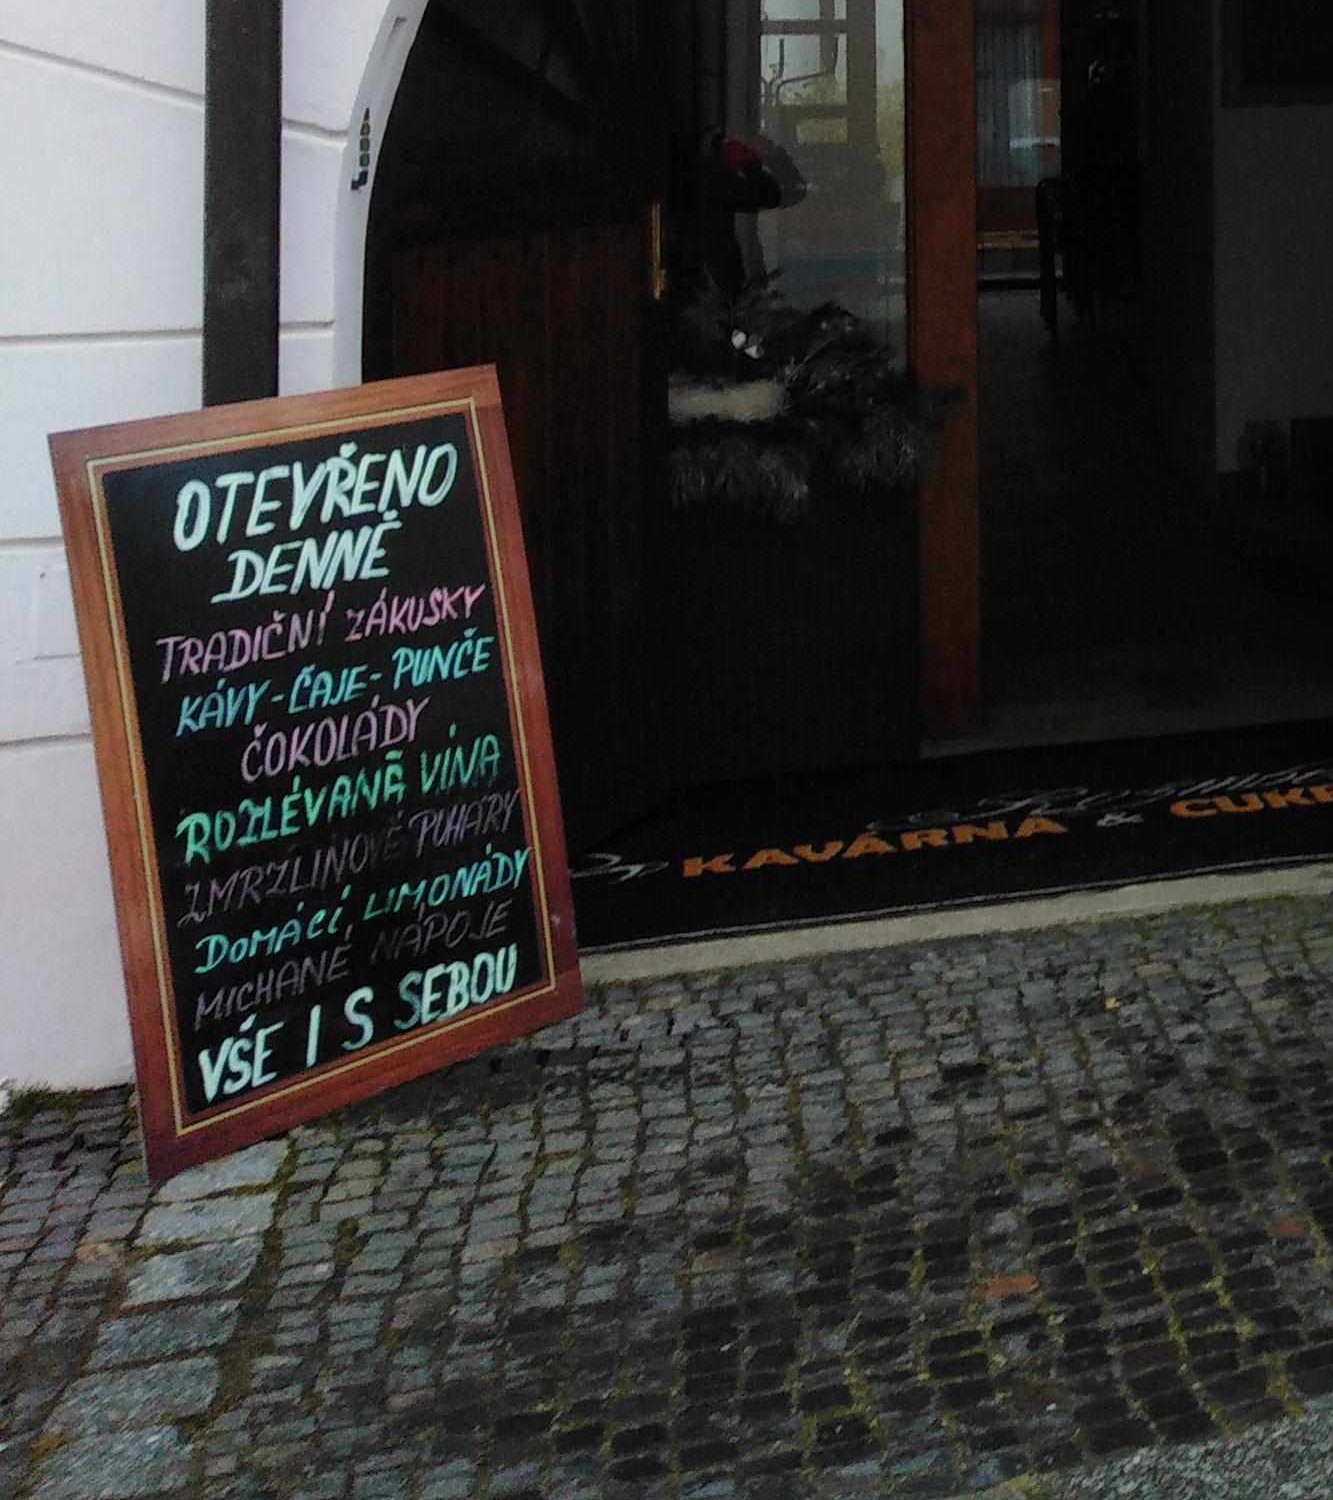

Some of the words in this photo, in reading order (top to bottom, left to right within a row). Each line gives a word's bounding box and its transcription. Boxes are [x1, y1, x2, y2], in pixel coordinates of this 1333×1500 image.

[173, 441, 459, 553] OTEVŘENO
[210, 510, 402, 604] DENNĚ
[155, 589, 336, 685] TRADIČNÍ
[345, 583, 487, 642] ZÁKUSKY
[391, 626, 497, 691] PUNČE
[241, 694, 432, 785] ČOKOLÁDY
[418, 722, 502, 798] VÍNA
[363, 841, 532, 922] LIMONÁDY
[682, 815, 1069, 879] KAVÁRNA
[1096, 810, 1145, 829] &
[198, 1012, 288, 1103] VŠE
[306, 1003, 321, 1069] I
[341, 986, 375, 1052] S
[394, 942, 519, 1031] SEBOU
